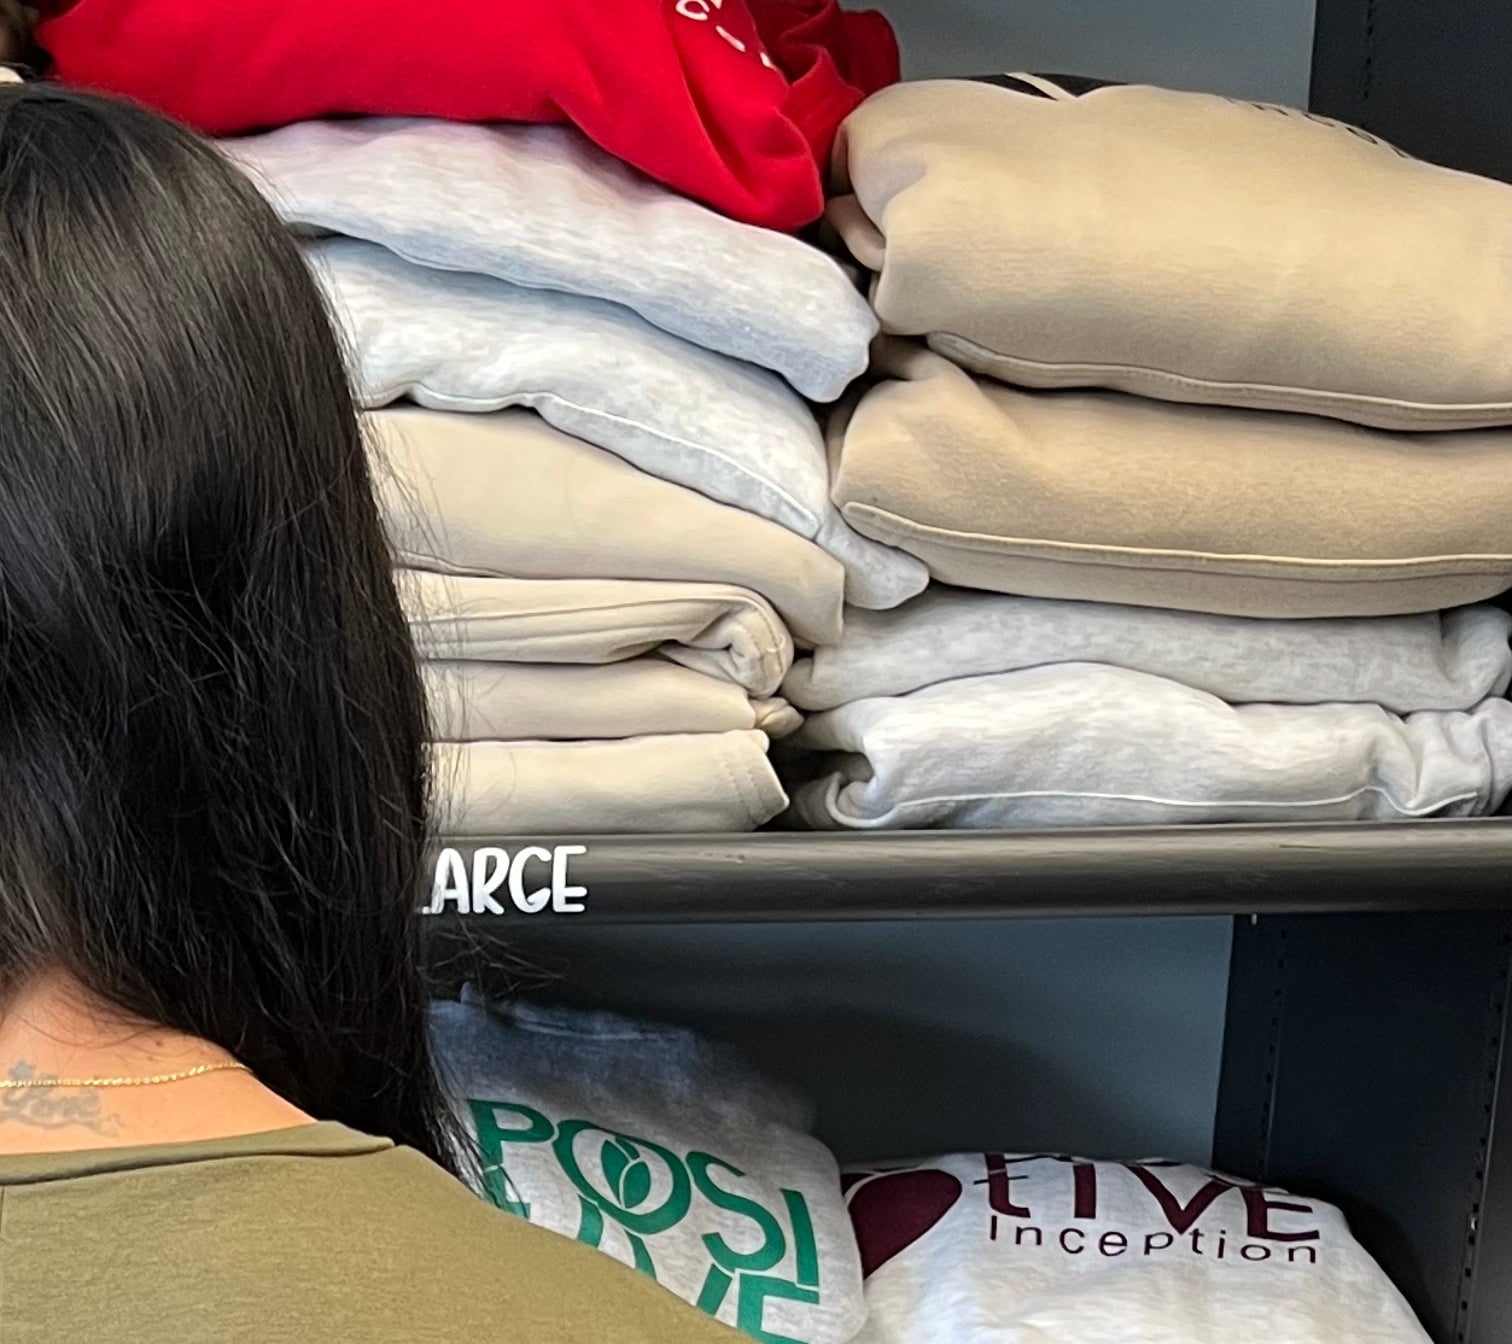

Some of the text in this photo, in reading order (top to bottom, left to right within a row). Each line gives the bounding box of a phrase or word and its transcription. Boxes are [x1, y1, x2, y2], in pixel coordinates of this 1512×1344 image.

[421, 844, 588, 915] ARGE
[467, 1098, 820, 1287] POSI
[989, 1214, 1317, 1264] Inception
